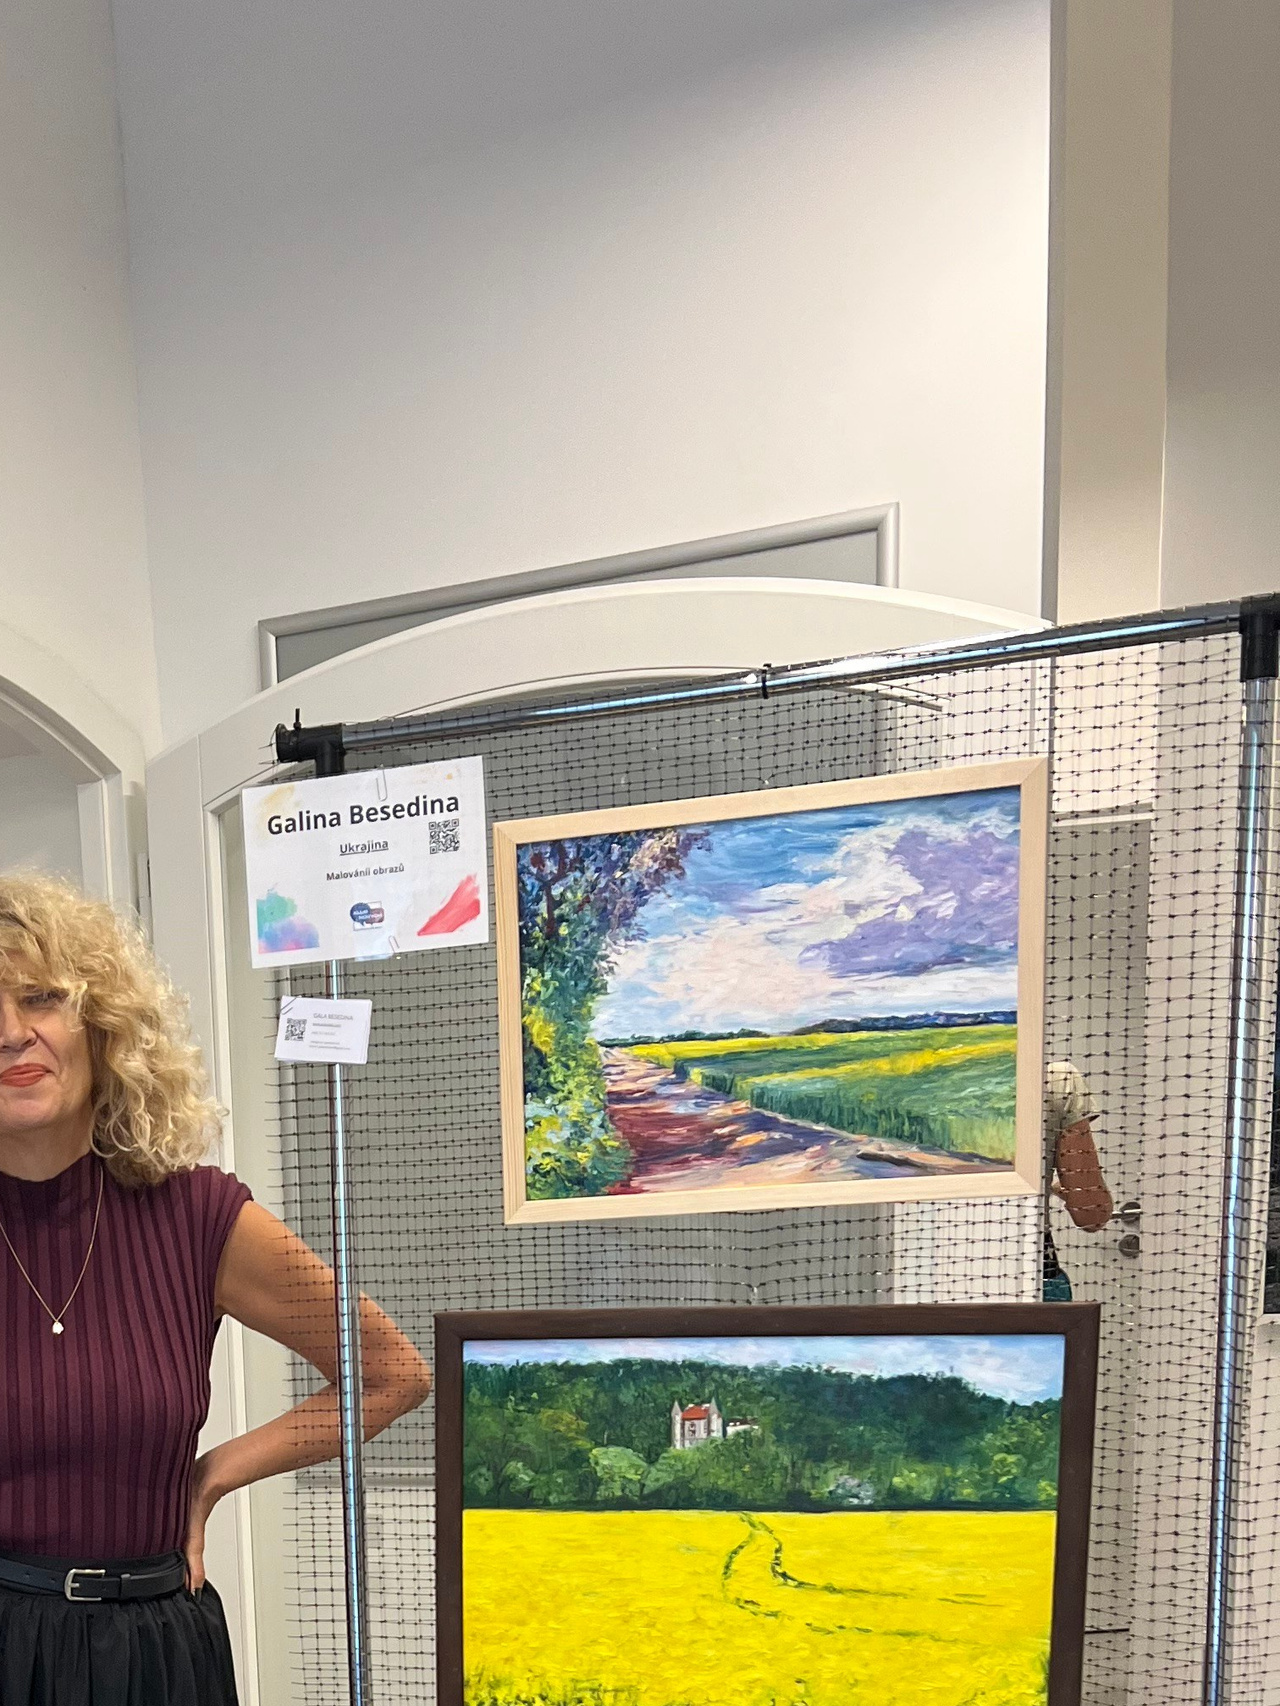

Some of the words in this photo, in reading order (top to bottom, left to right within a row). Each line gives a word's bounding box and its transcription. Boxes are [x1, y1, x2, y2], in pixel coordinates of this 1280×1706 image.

[267, 810, 341, 835] Galina
[350, 795, 460, 825] Besedina
[339, 840, 389, 855] Ukrajina
[373, 863, 405, 876] obrazů
